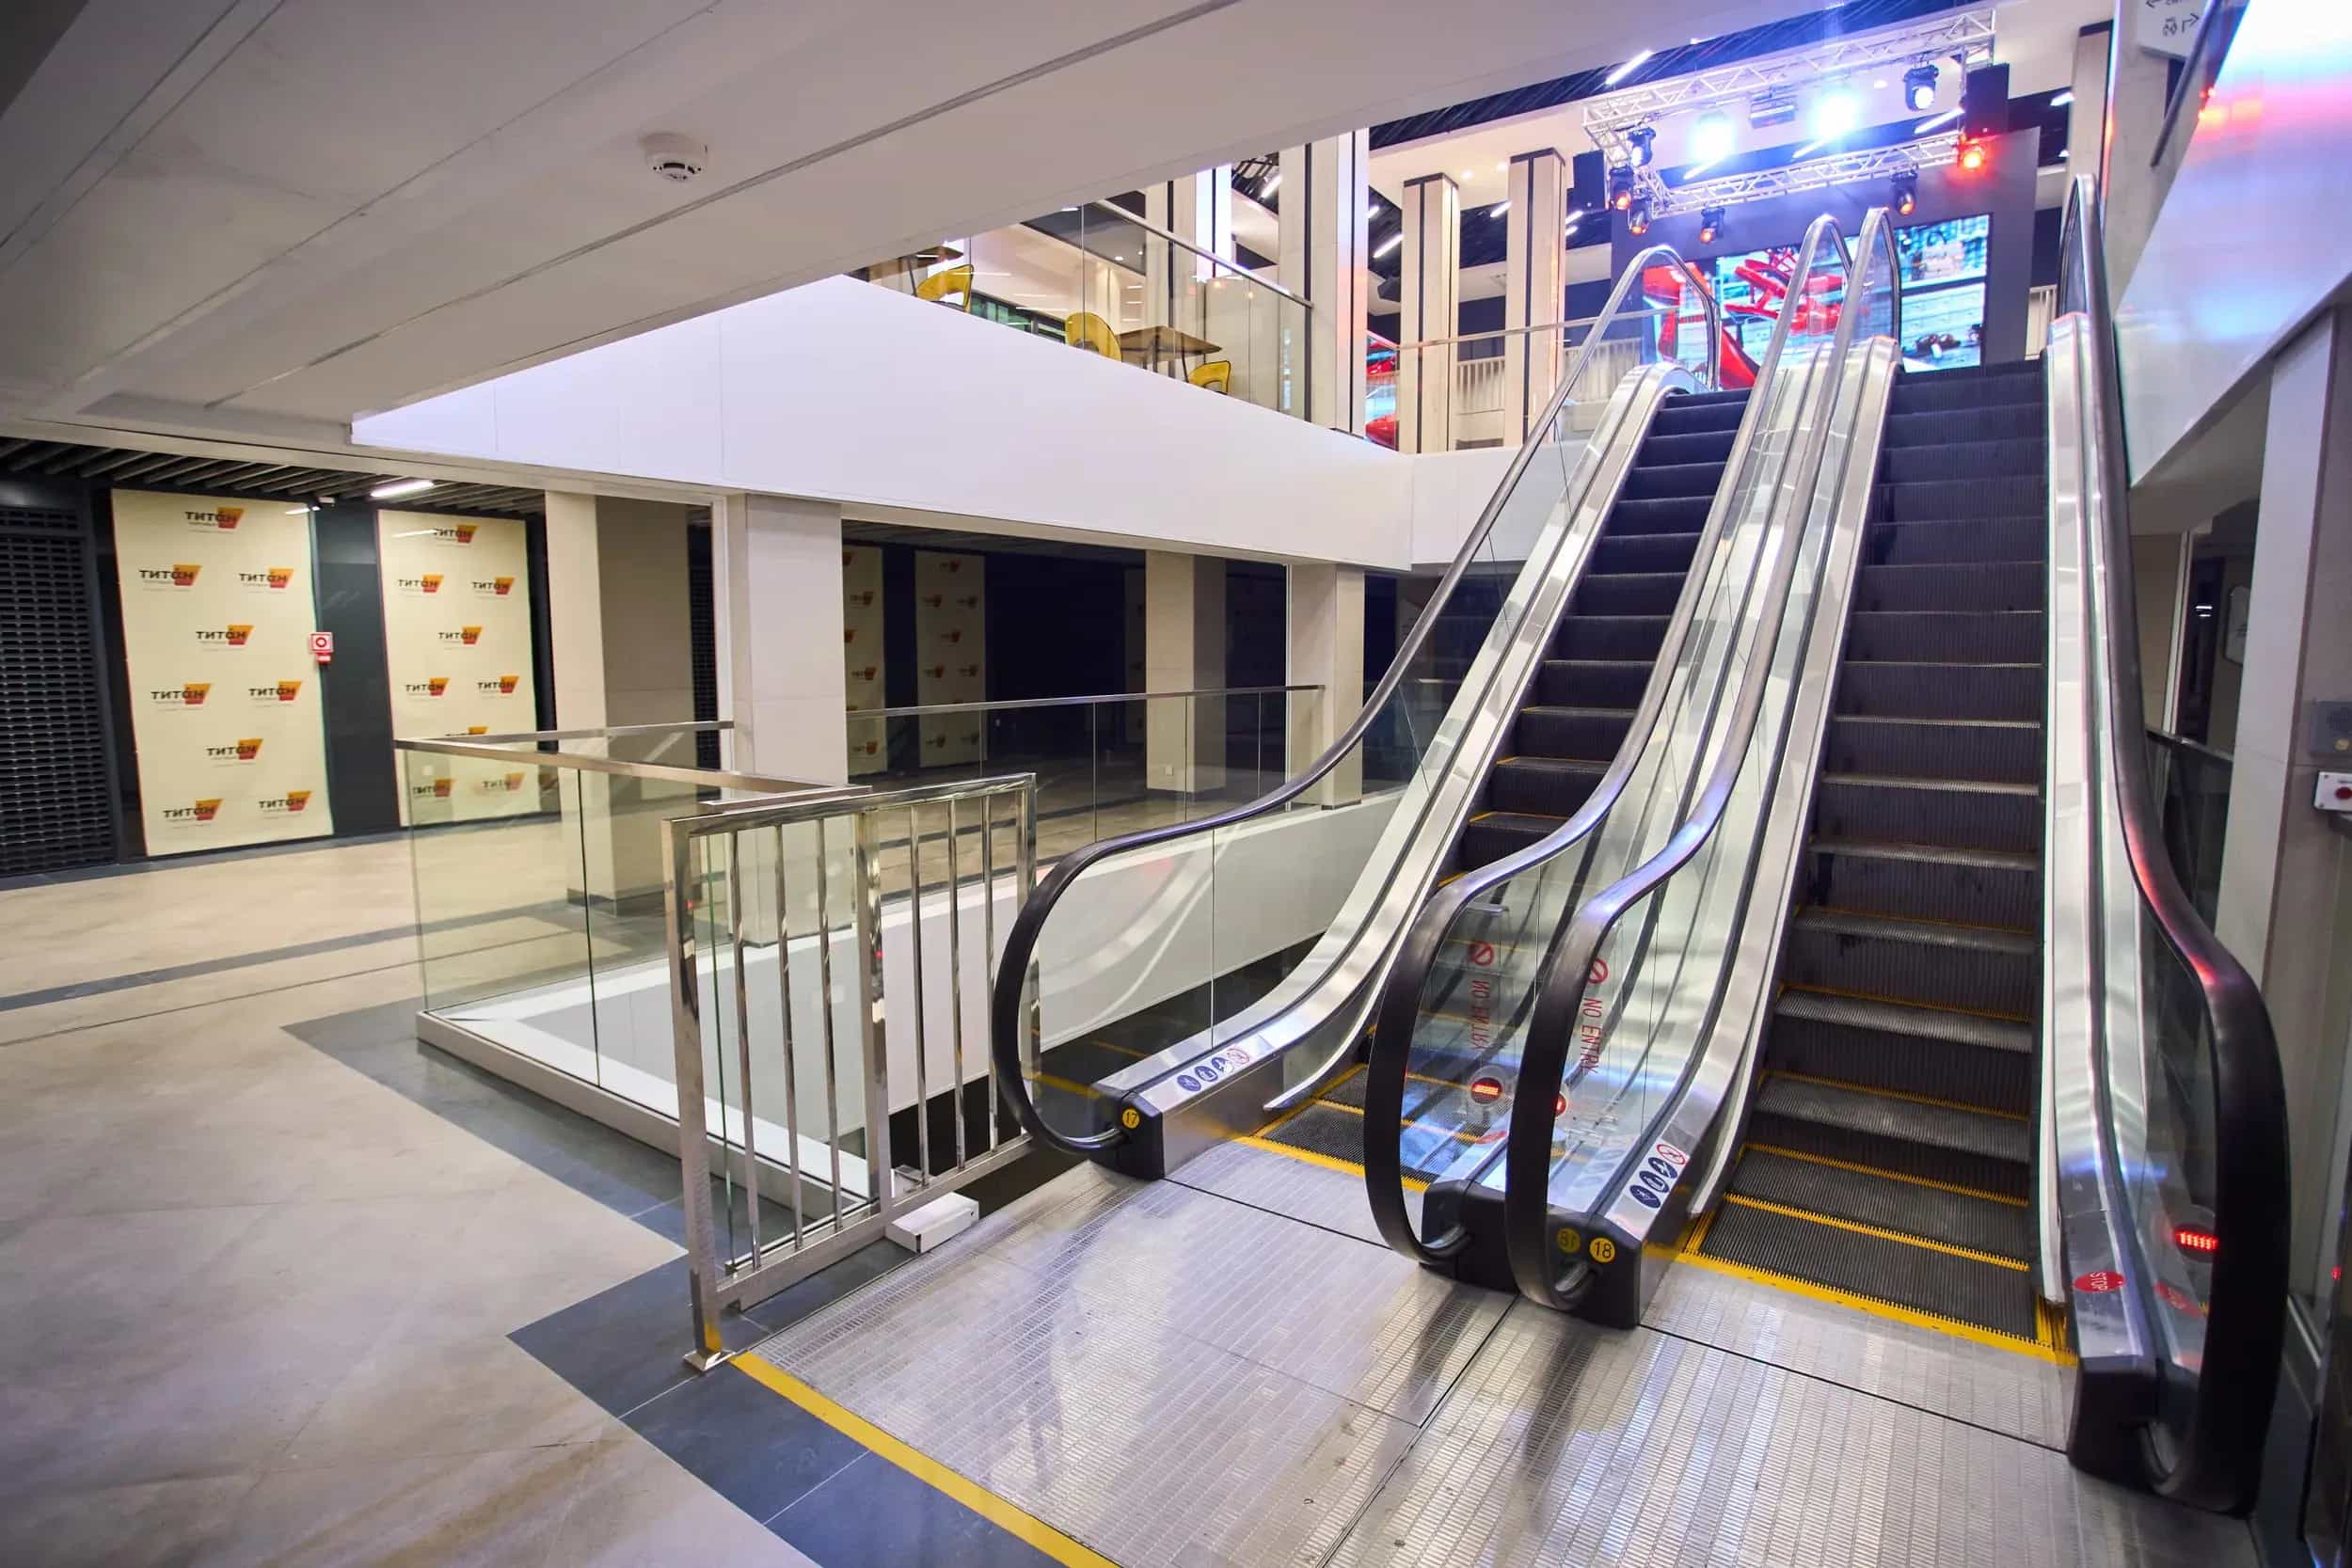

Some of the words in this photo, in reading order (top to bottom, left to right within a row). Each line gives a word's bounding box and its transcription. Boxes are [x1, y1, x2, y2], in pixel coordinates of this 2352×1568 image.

[1581, 997, 1604, 1019] NO
[1580, 1025, 1603, 1074] ENTRY
[1126, 1112, 1137, 1125] 17
[1595, 1241, 1613, 1259] 18
[2089, 1271, 2108, 1291] STOP
